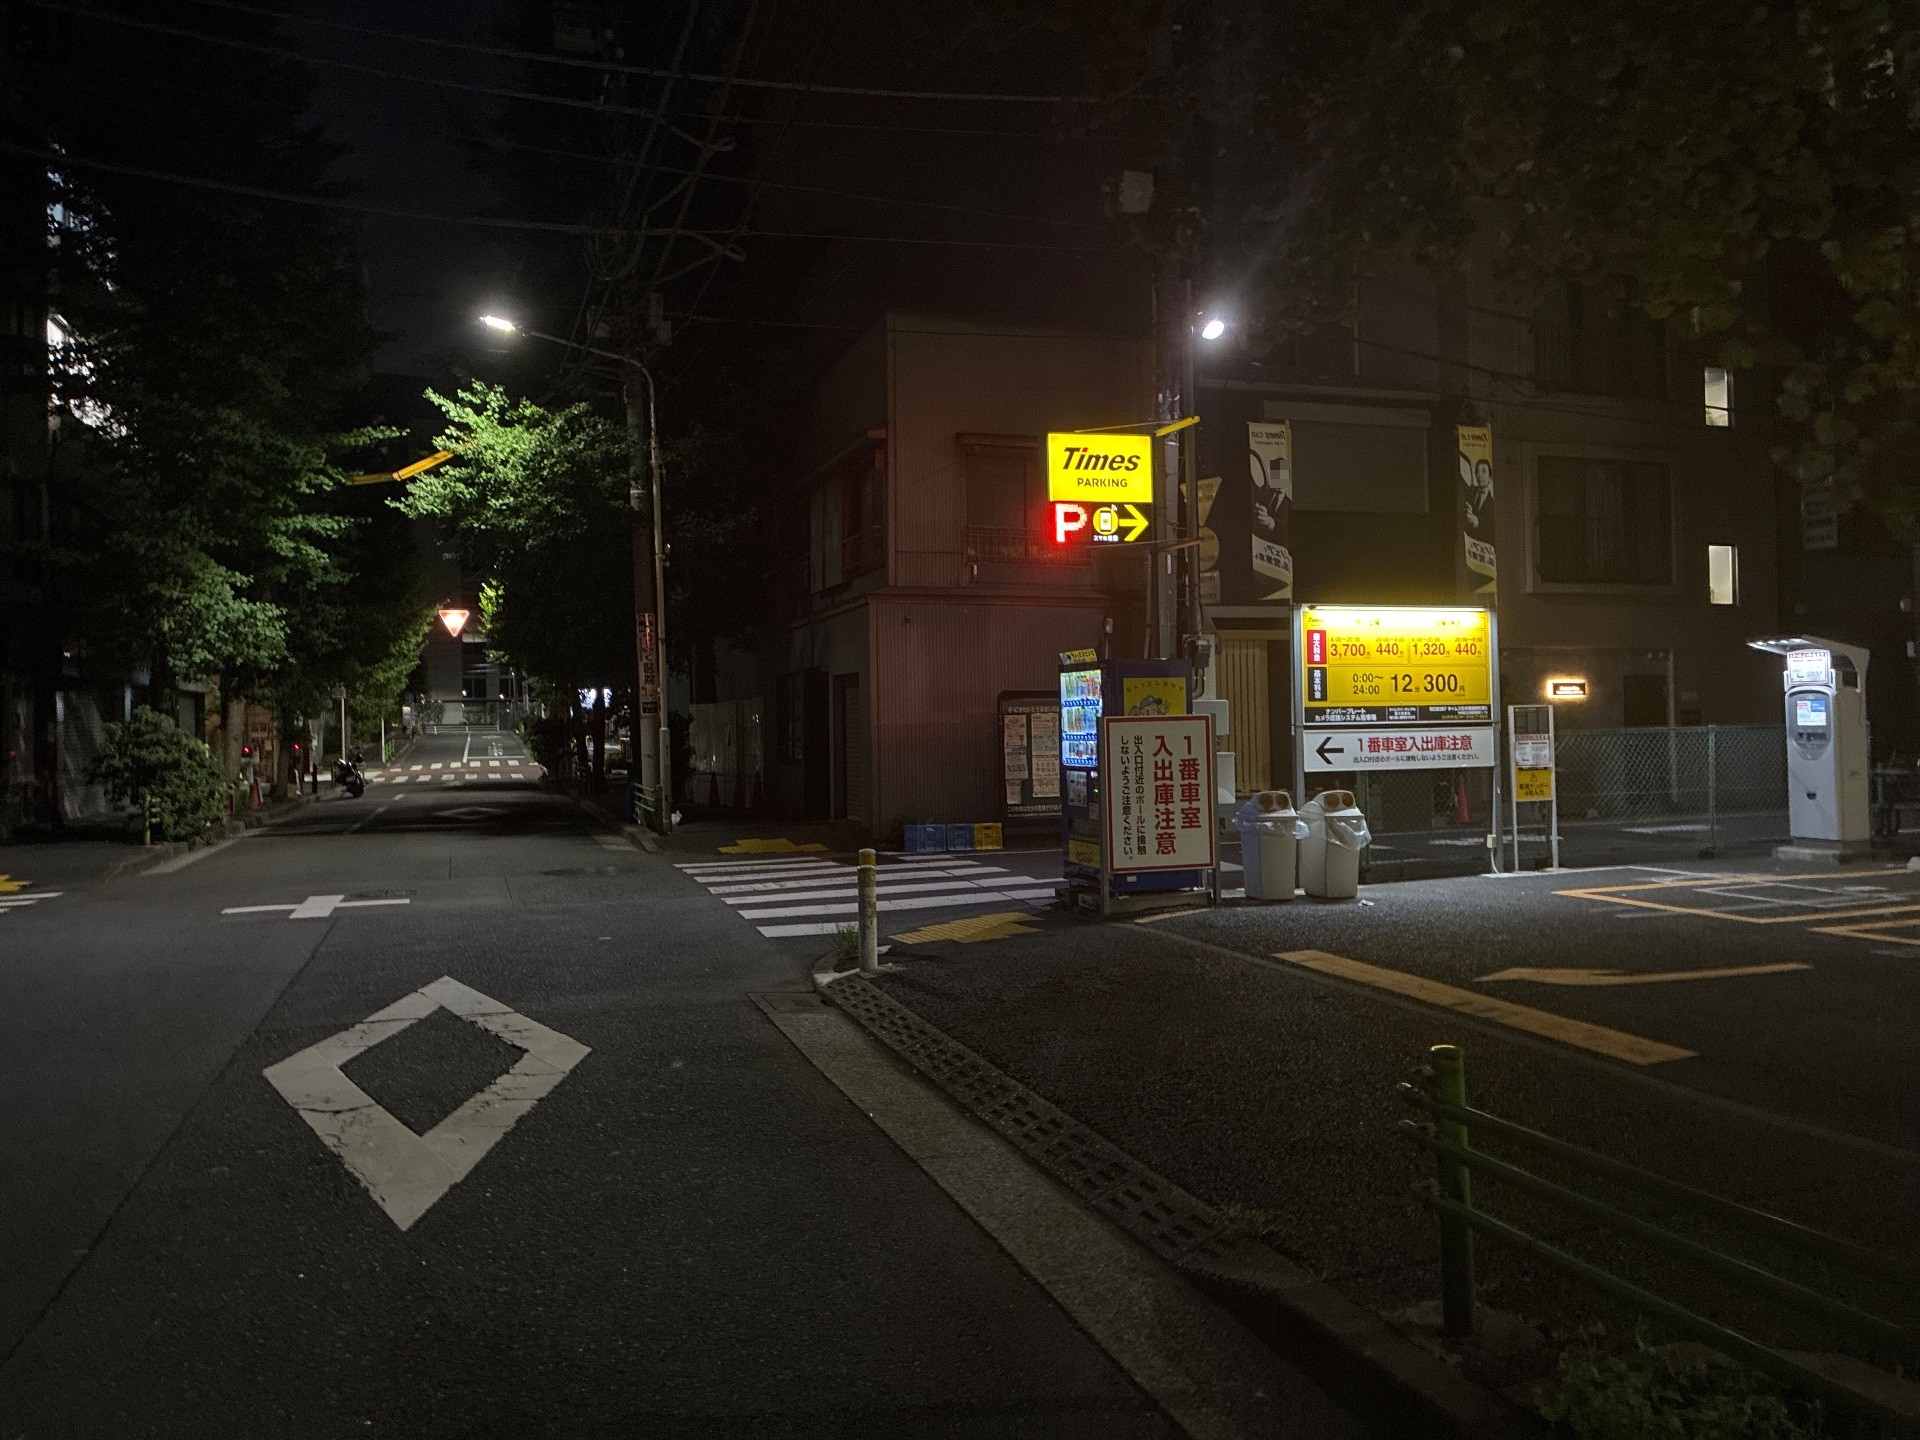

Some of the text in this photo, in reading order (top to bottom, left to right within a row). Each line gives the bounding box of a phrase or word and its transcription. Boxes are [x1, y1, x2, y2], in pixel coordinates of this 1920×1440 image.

[1062, 447, 1141, 472] Times
[1077, 477, 1128, 488] PARKING
[1055, 503, 1088, 543] P
[1352, 685, 1380, 695] 24:00
[1325, 707, 1366, 715] ナンバープレート
[1357, 735, 1473, 753] 1番車室入出庫注意
[1152, 735, 1177, 855] 入出庫注意
[1178, 735, 1201, 830] 1番車室
[1120, 735, 1133, 860] しないようご注意ください。
